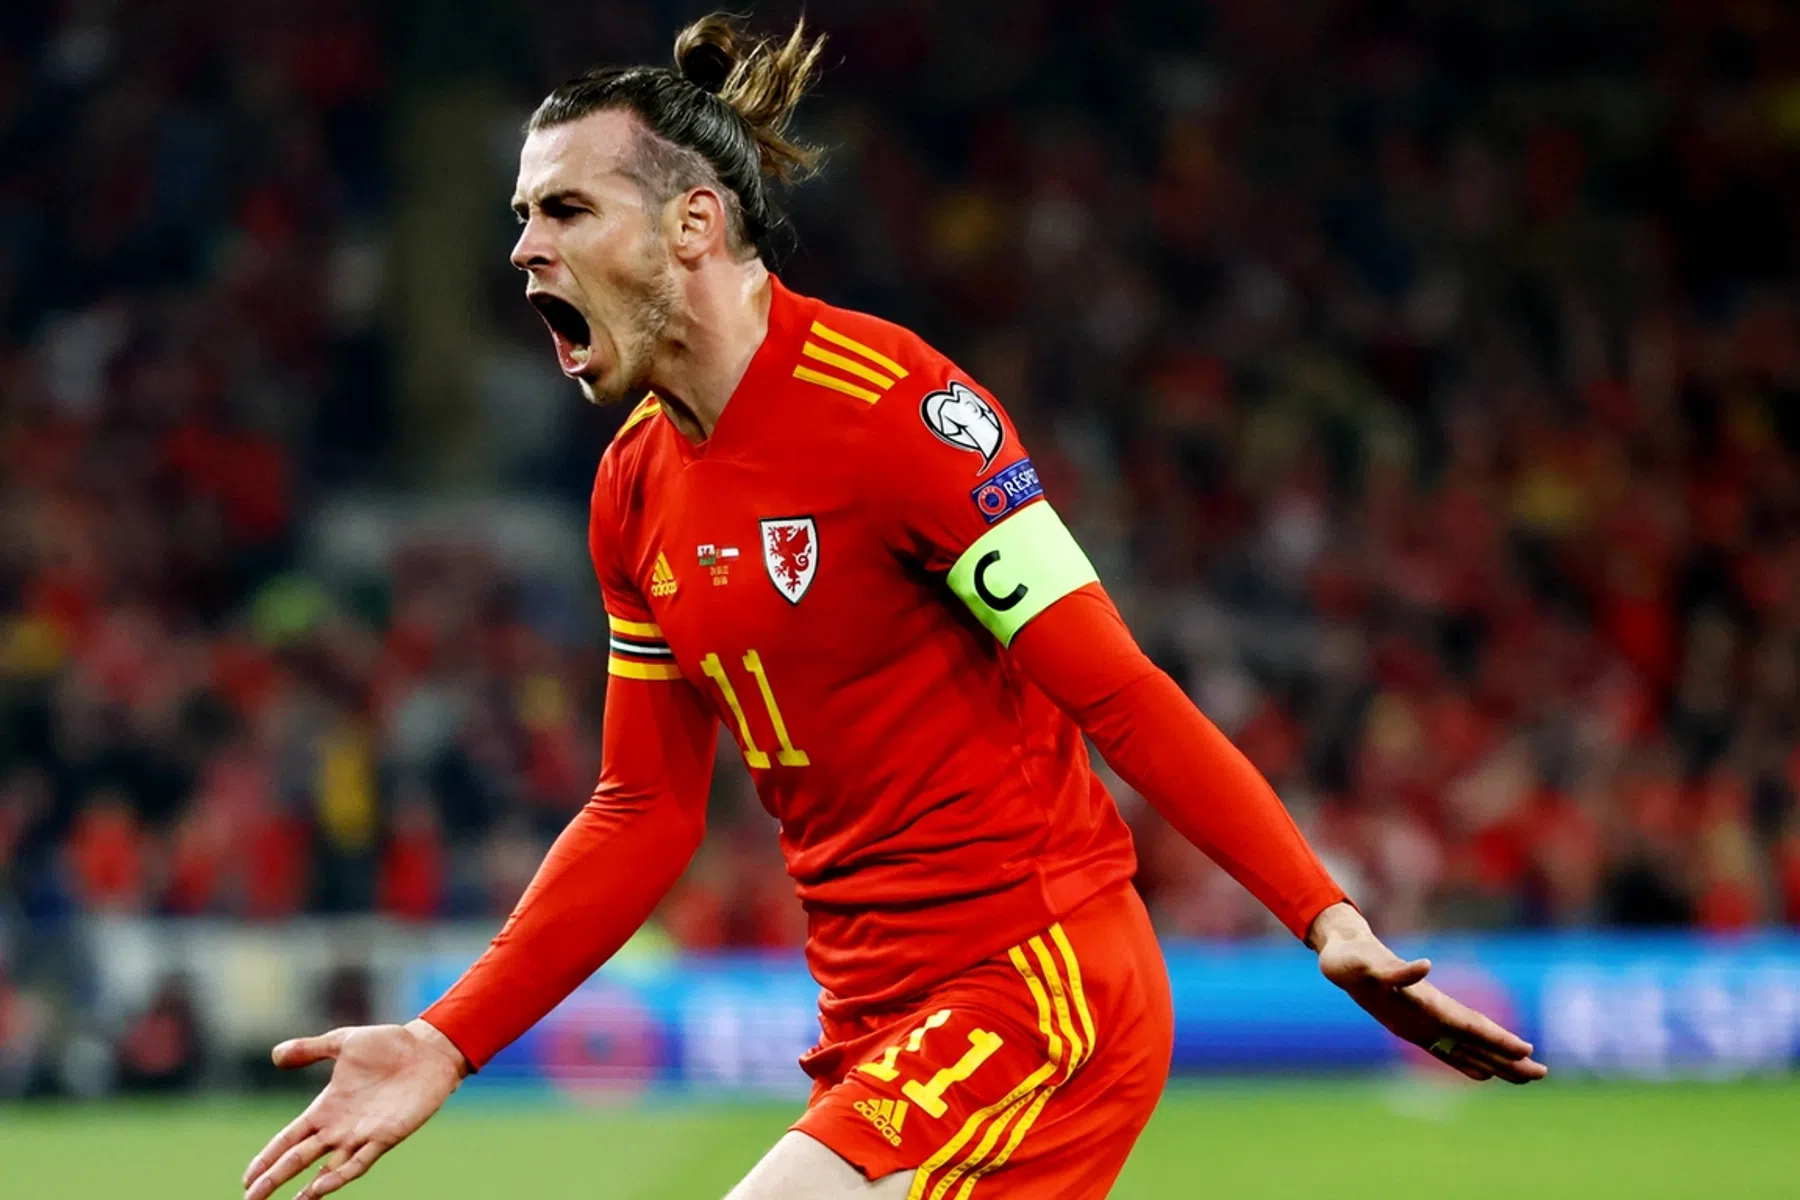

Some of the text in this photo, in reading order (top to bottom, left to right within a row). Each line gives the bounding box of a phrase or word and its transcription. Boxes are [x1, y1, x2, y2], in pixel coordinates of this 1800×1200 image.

[974, 550, 1029, 612] C
[700, 649, 811, 769] 11
[856, 1009, 1004, 1119] 11
[853, 1101, 902, 1147] adidas
